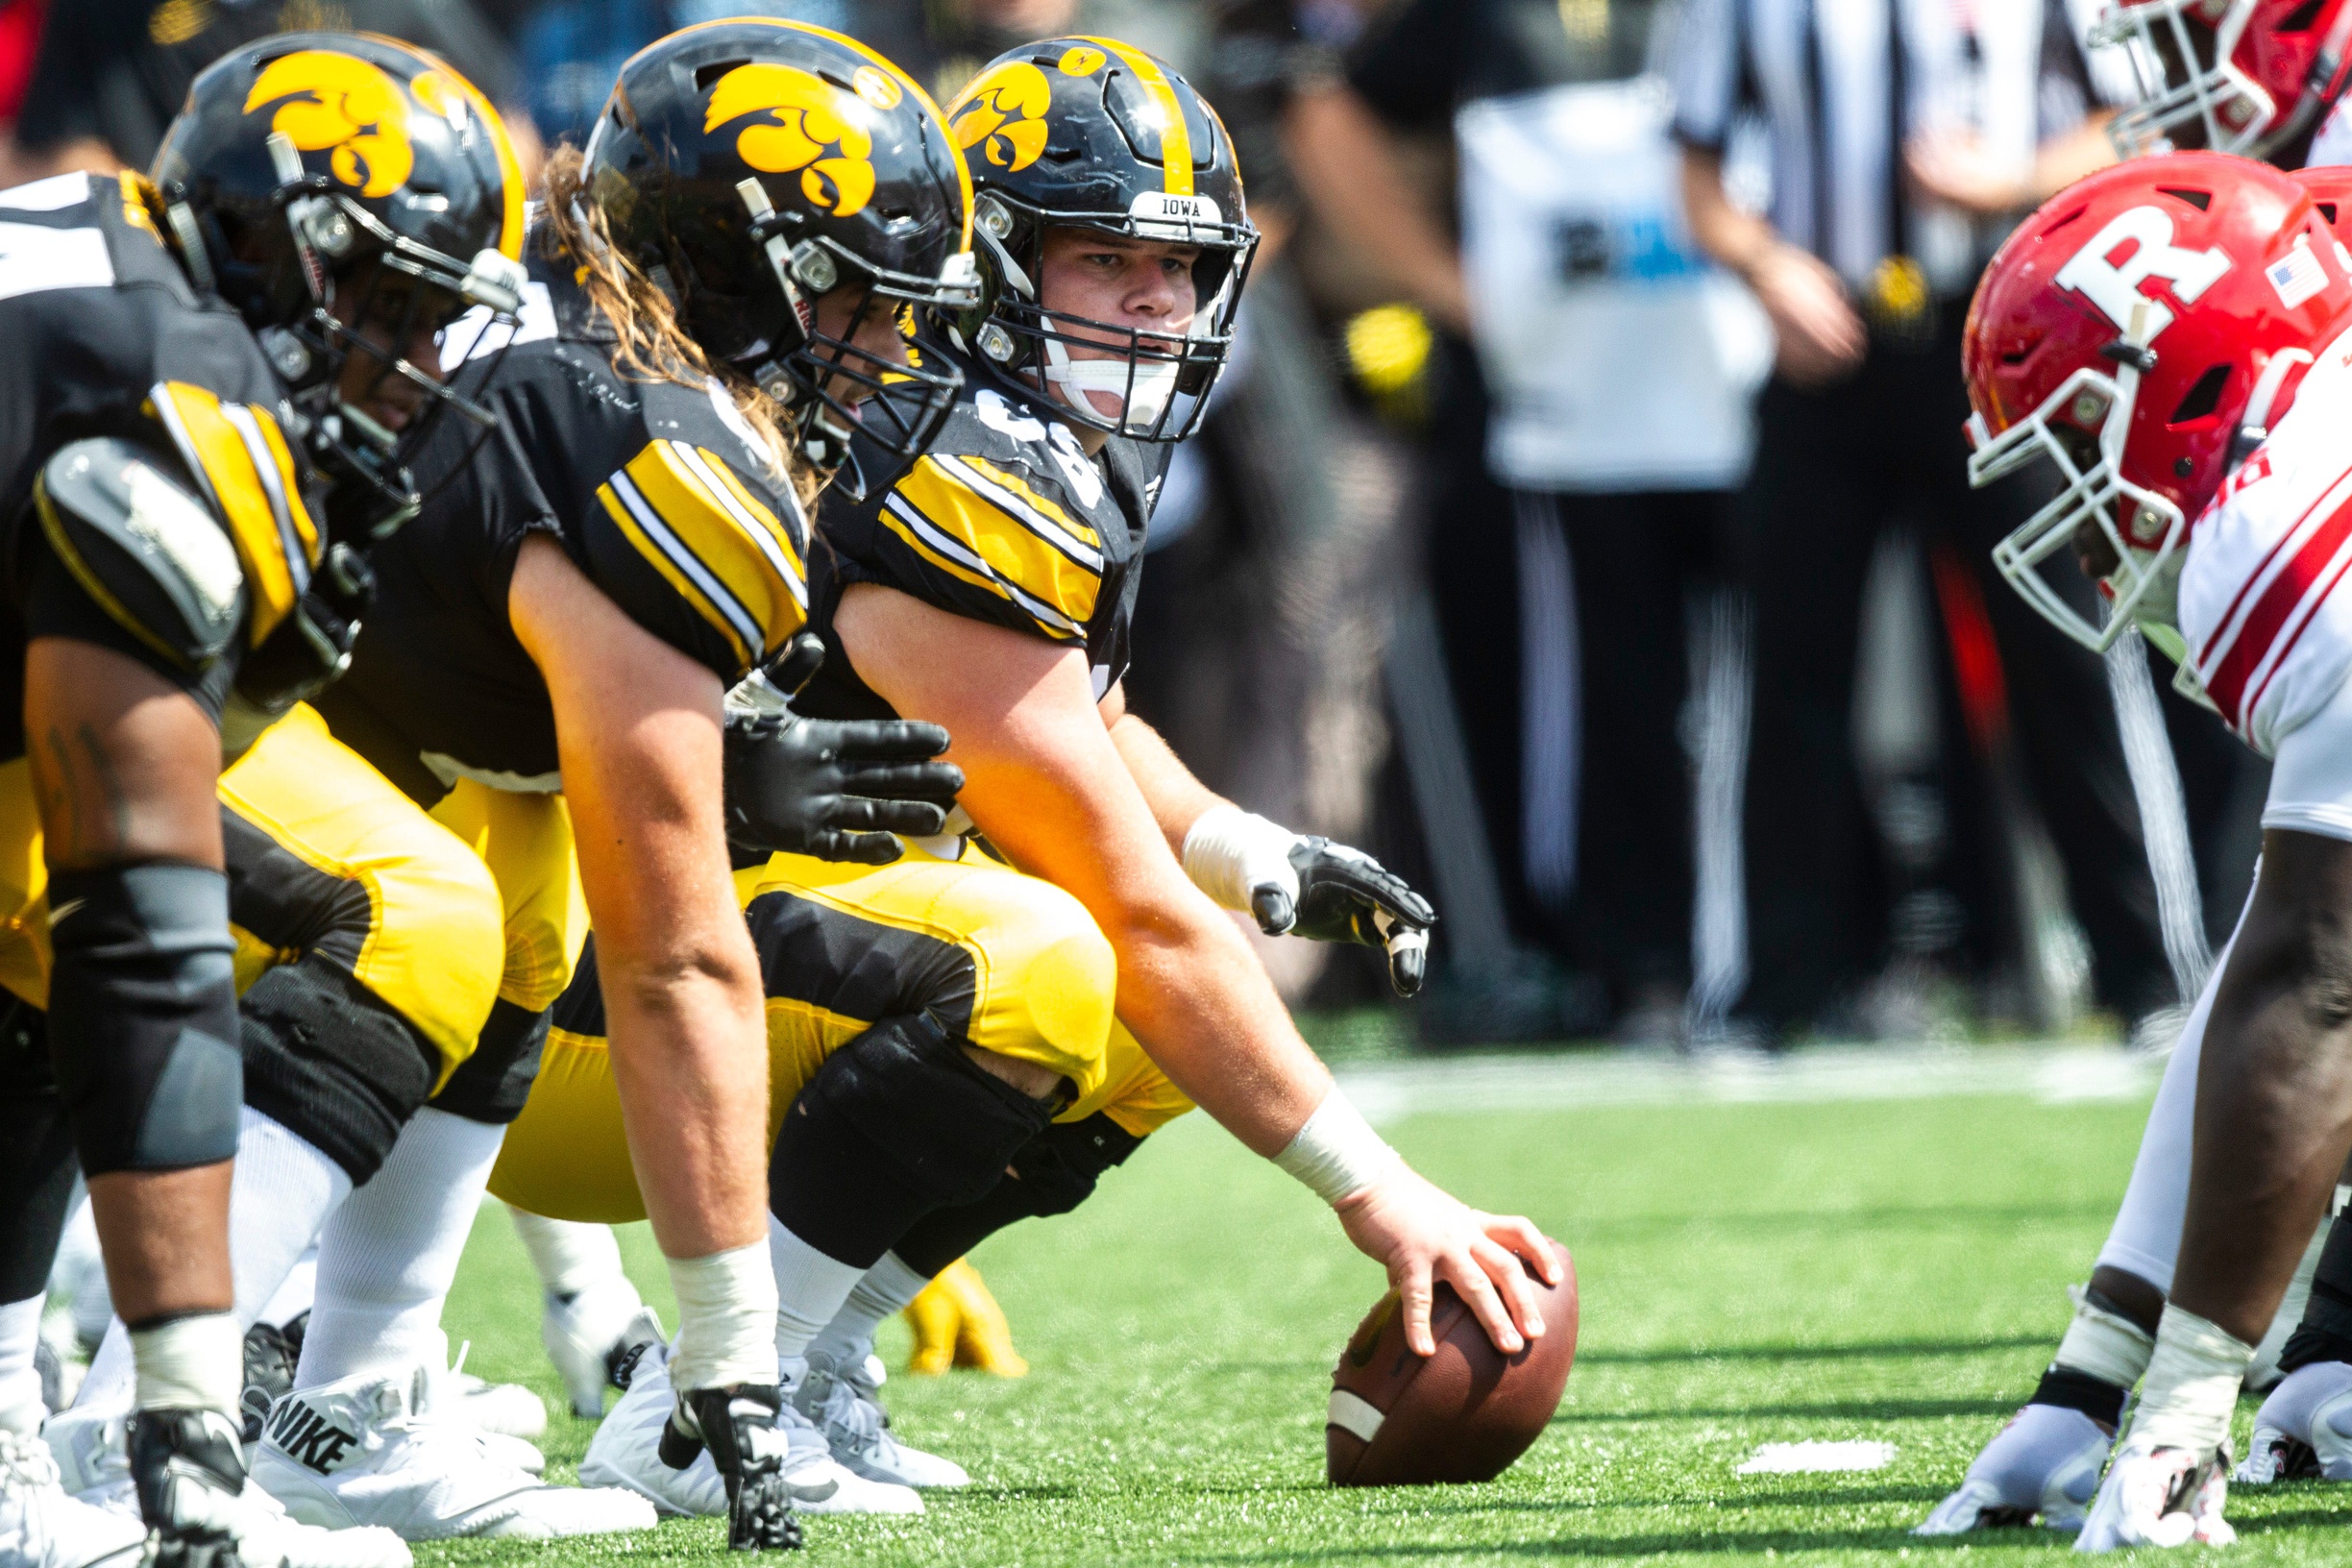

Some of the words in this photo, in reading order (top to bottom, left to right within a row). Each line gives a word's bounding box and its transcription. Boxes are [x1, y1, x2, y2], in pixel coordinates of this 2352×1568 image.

[1162, 198, 1201, 217] IOWA
[2053, 205, 2233, 348] R
[268, 1399, 358, 1477] NIKE
